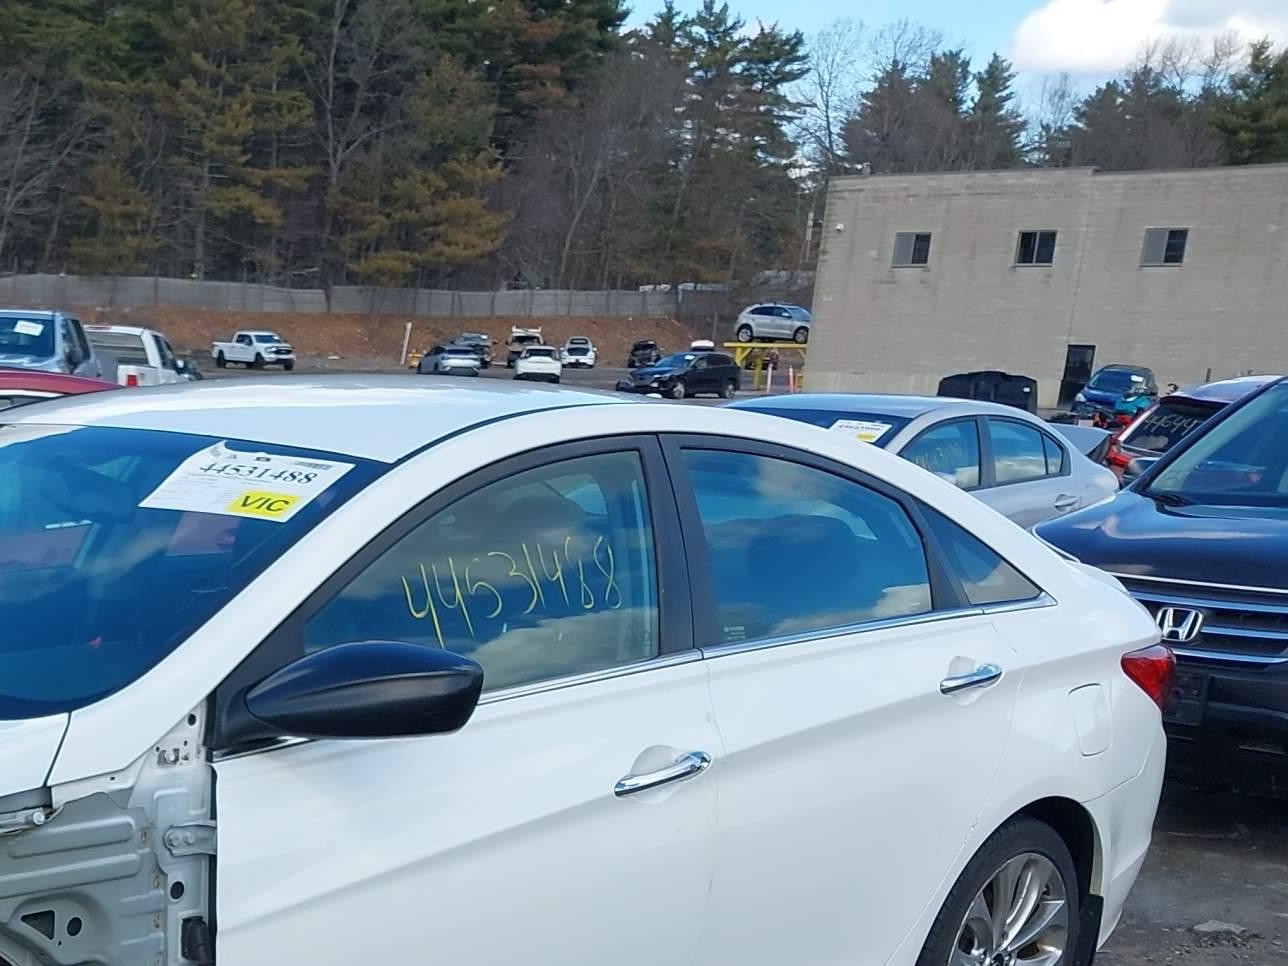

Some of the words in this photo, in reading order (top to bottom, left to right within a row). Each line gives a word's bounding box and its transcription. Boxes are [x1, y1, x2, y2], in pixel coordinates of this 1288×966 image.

[1144, 414, 1203, 436] 44644
[199, 461, 318, 485] 44531488
[240, 495, 290, 512] VIC
